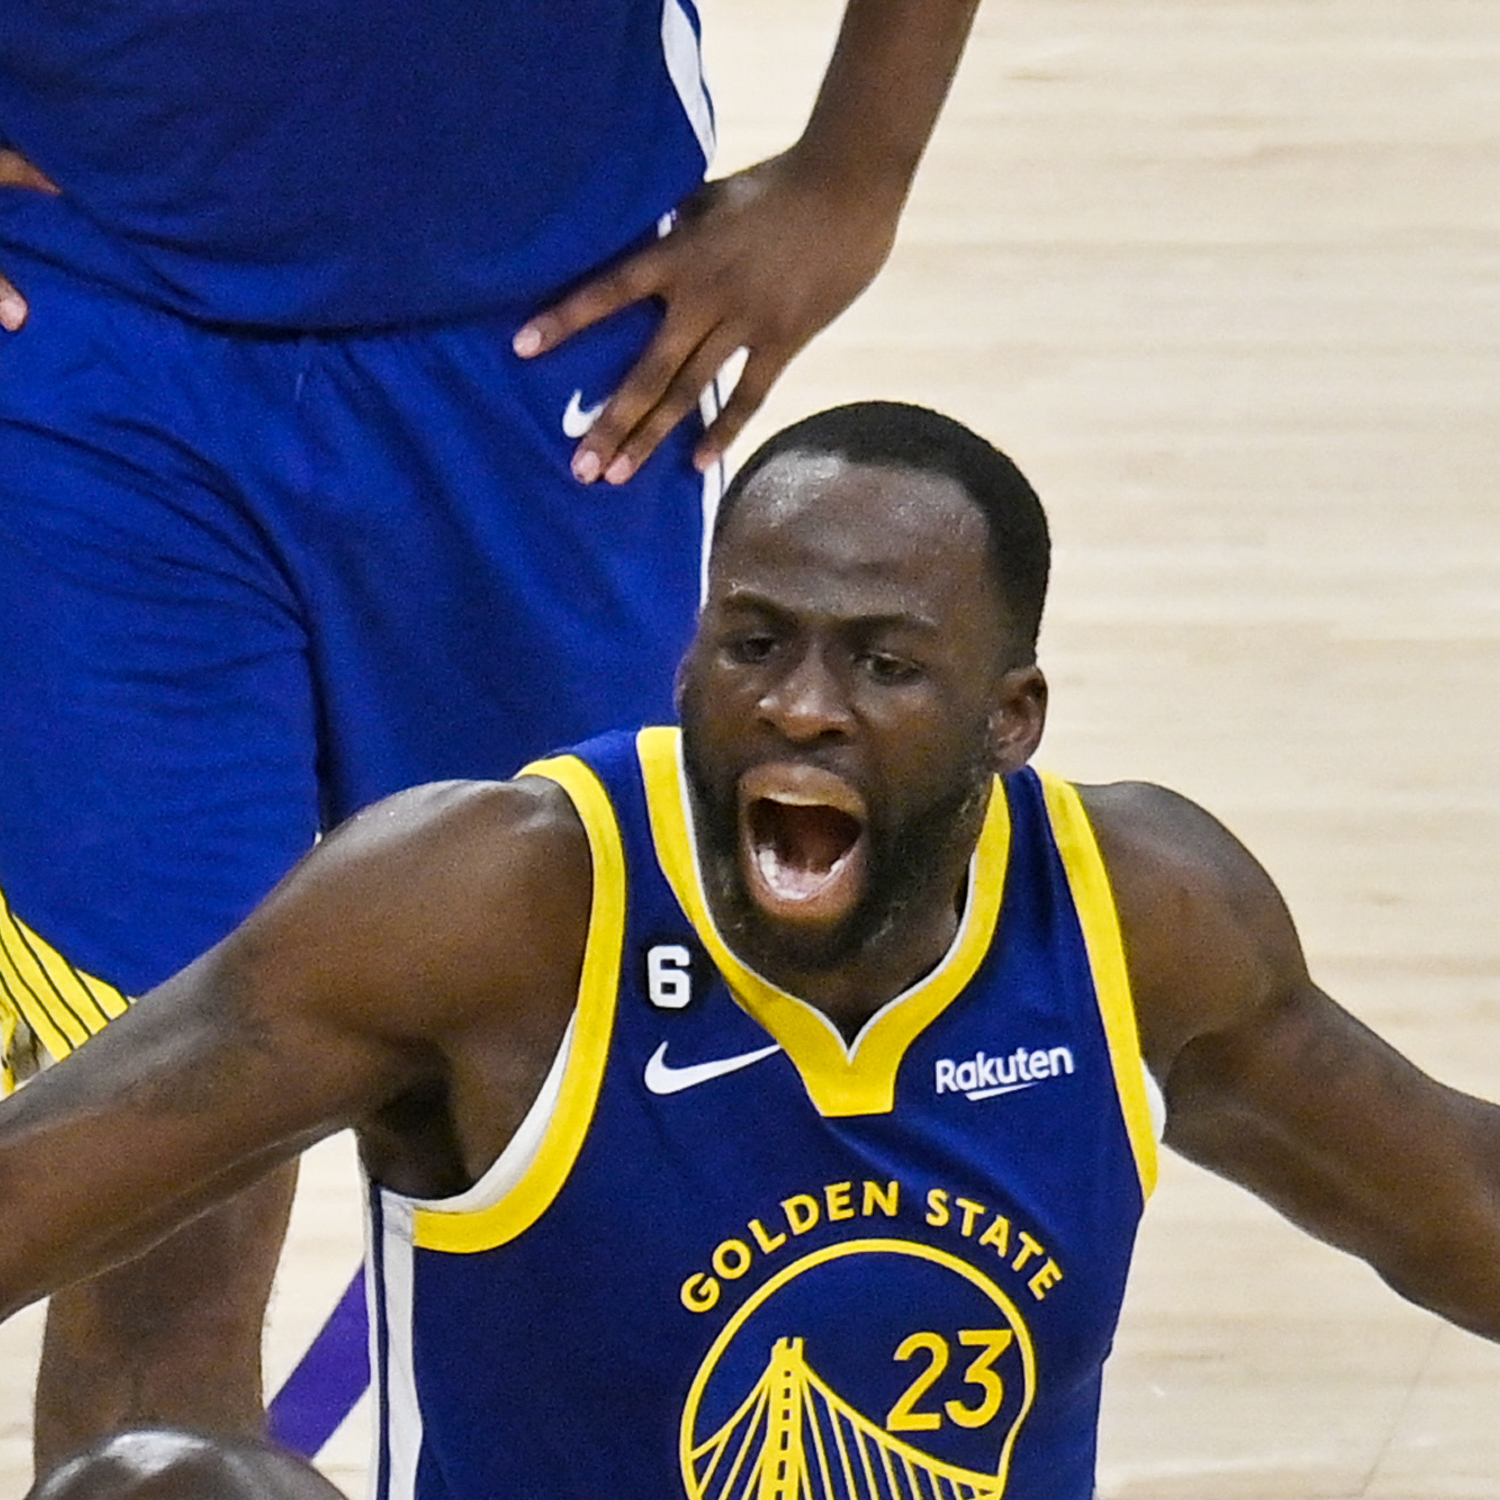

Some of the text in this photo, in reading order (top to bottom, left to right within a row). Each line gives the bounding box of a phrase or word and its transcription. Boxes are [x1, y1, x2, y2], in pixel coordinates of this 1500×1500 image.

[646, 944, 692, 1009] 6
[935, 1046, 1074, 1096] Rakuten
[680, 1180, 1063, 1313] GOLDEN STATE
[885, 1329, 1013, 1432] 23
